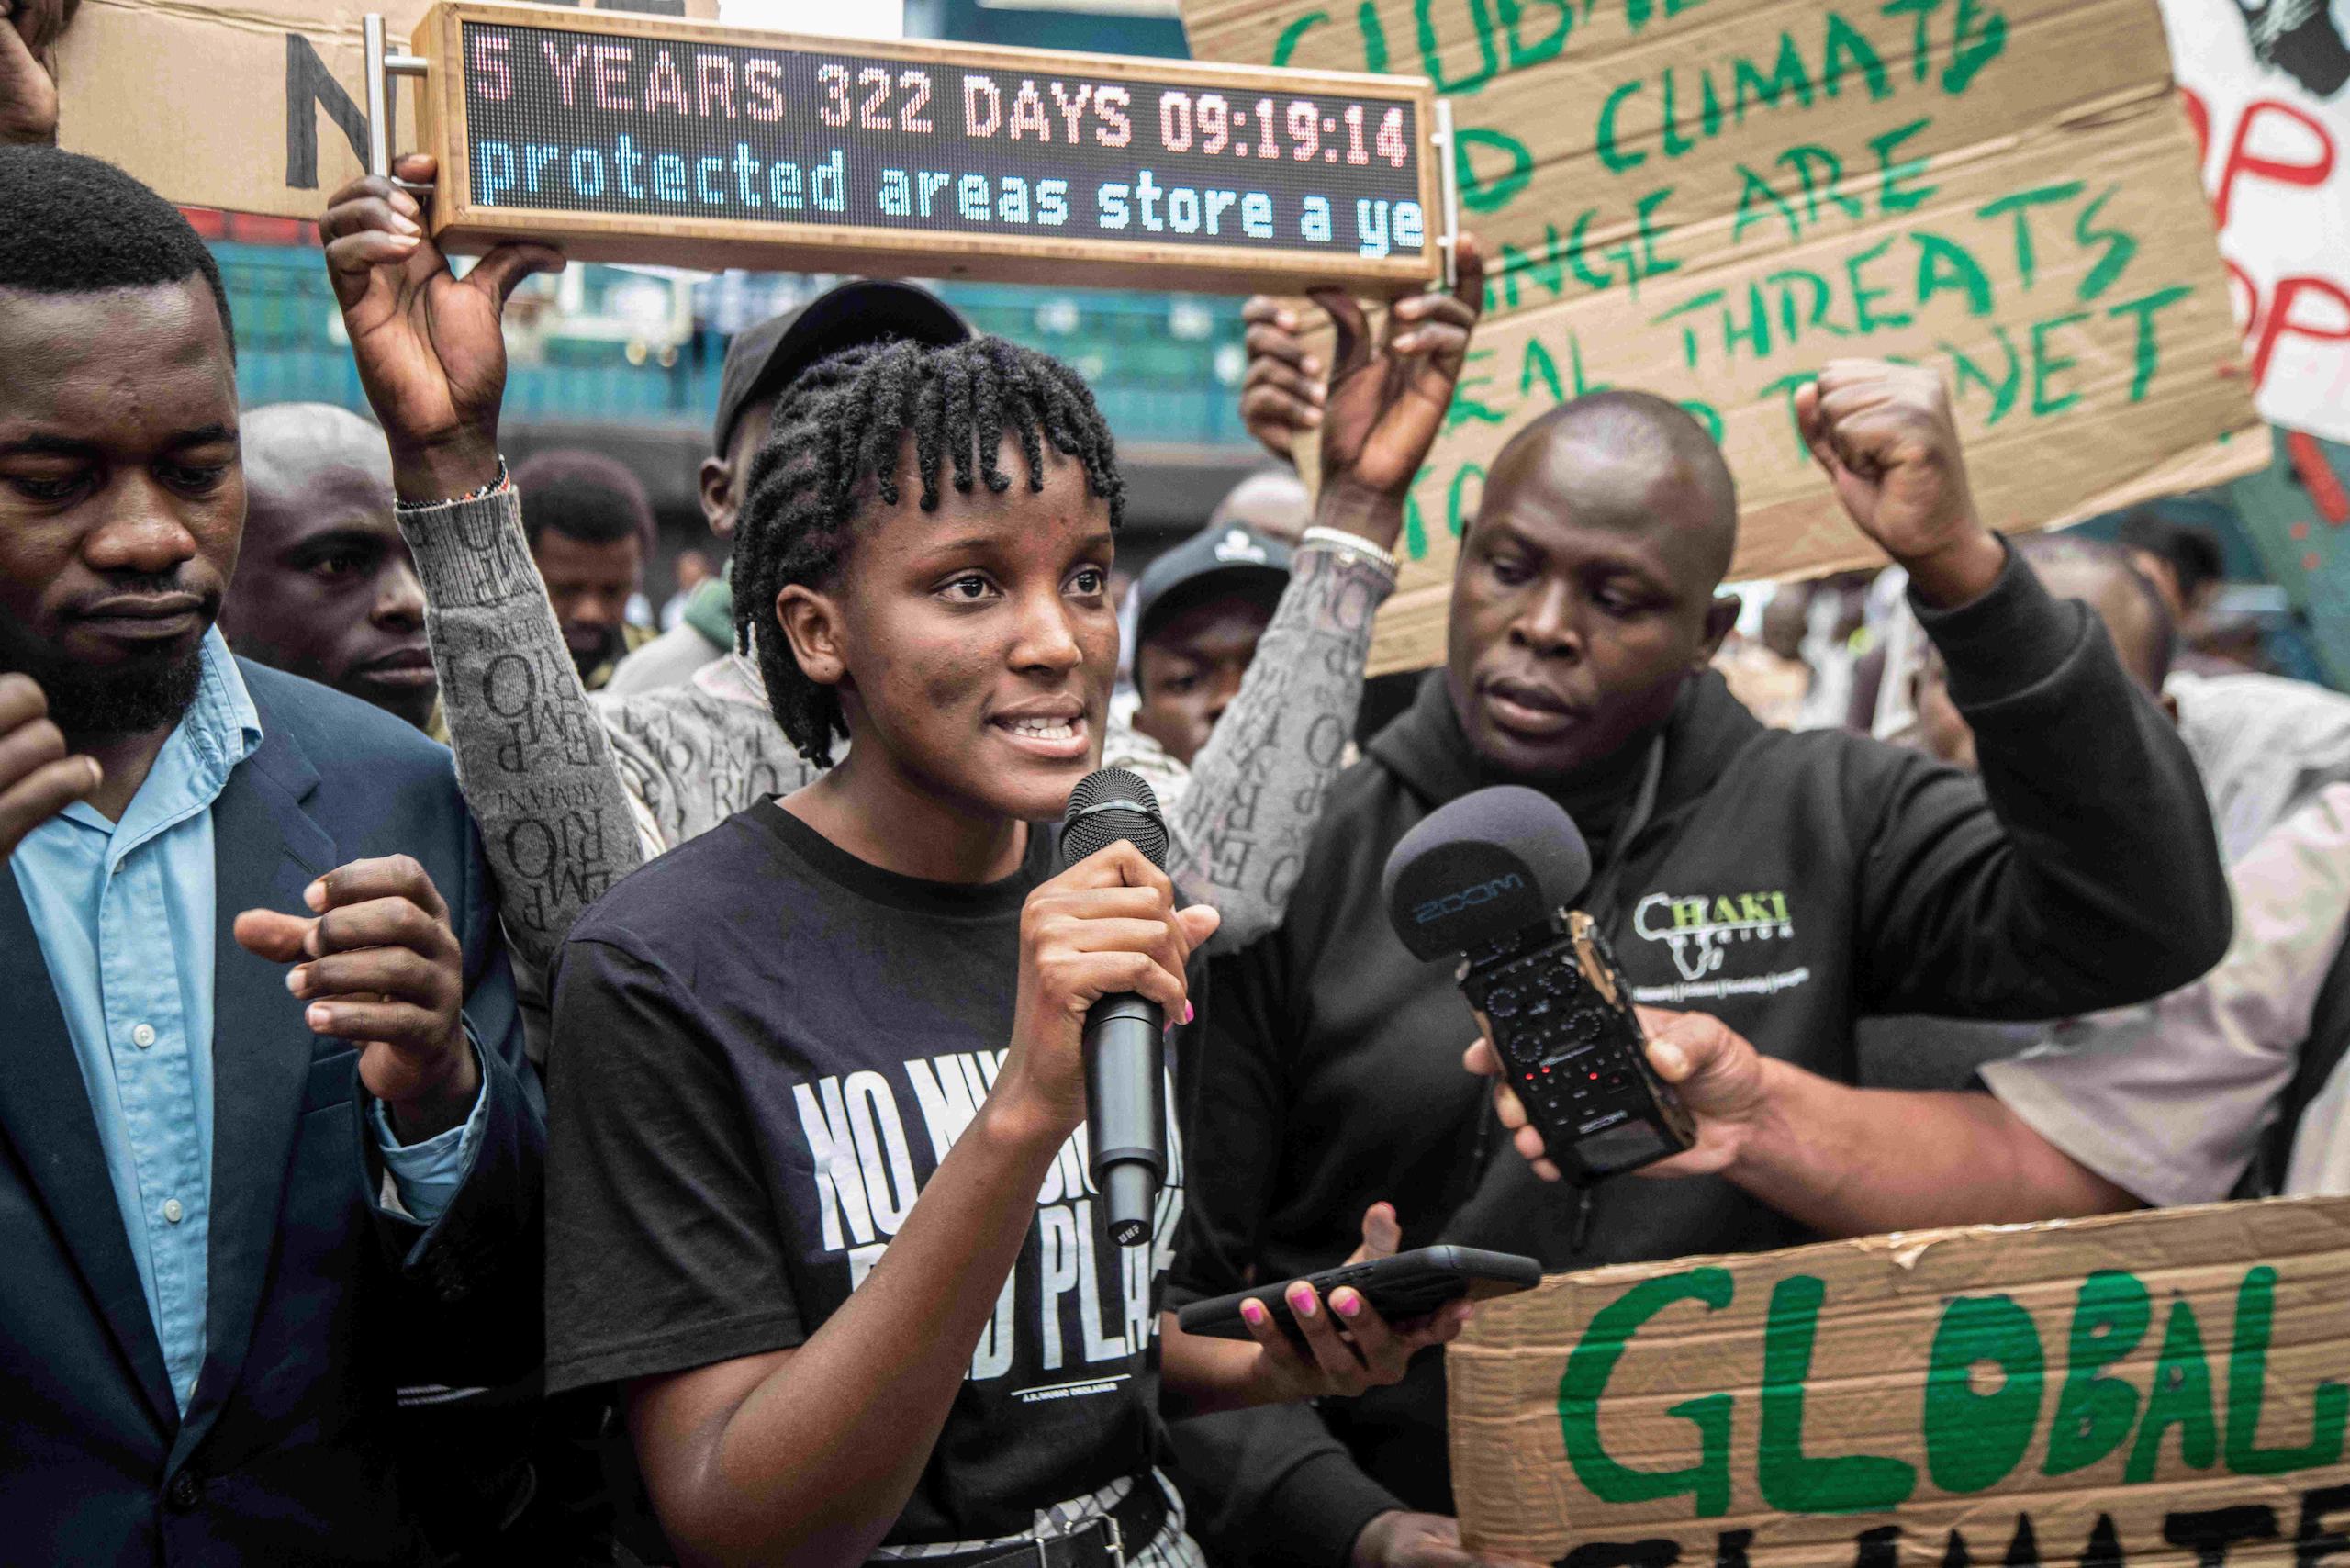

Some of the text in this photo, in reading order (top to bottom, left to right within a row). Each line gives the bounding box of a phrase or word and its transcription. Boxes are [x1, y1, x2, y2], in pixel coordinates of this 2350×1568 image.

[474, 36, 1408, 168] 5 YEARS 322 DAYS 09:19:14
[1595, 0, 2009, 174] CLIMATE
[479, 133, 1424, 258] protected areas store a ye
[1733, 118, 1939, 242] ARE
[1650, 179, 2139, 369] THREATS
[792, 1070, 919, 1252] NO
[1117, 1223, 1140, 1244] UHF
[1559, 1266, 2350, 1518] GLOBAL
